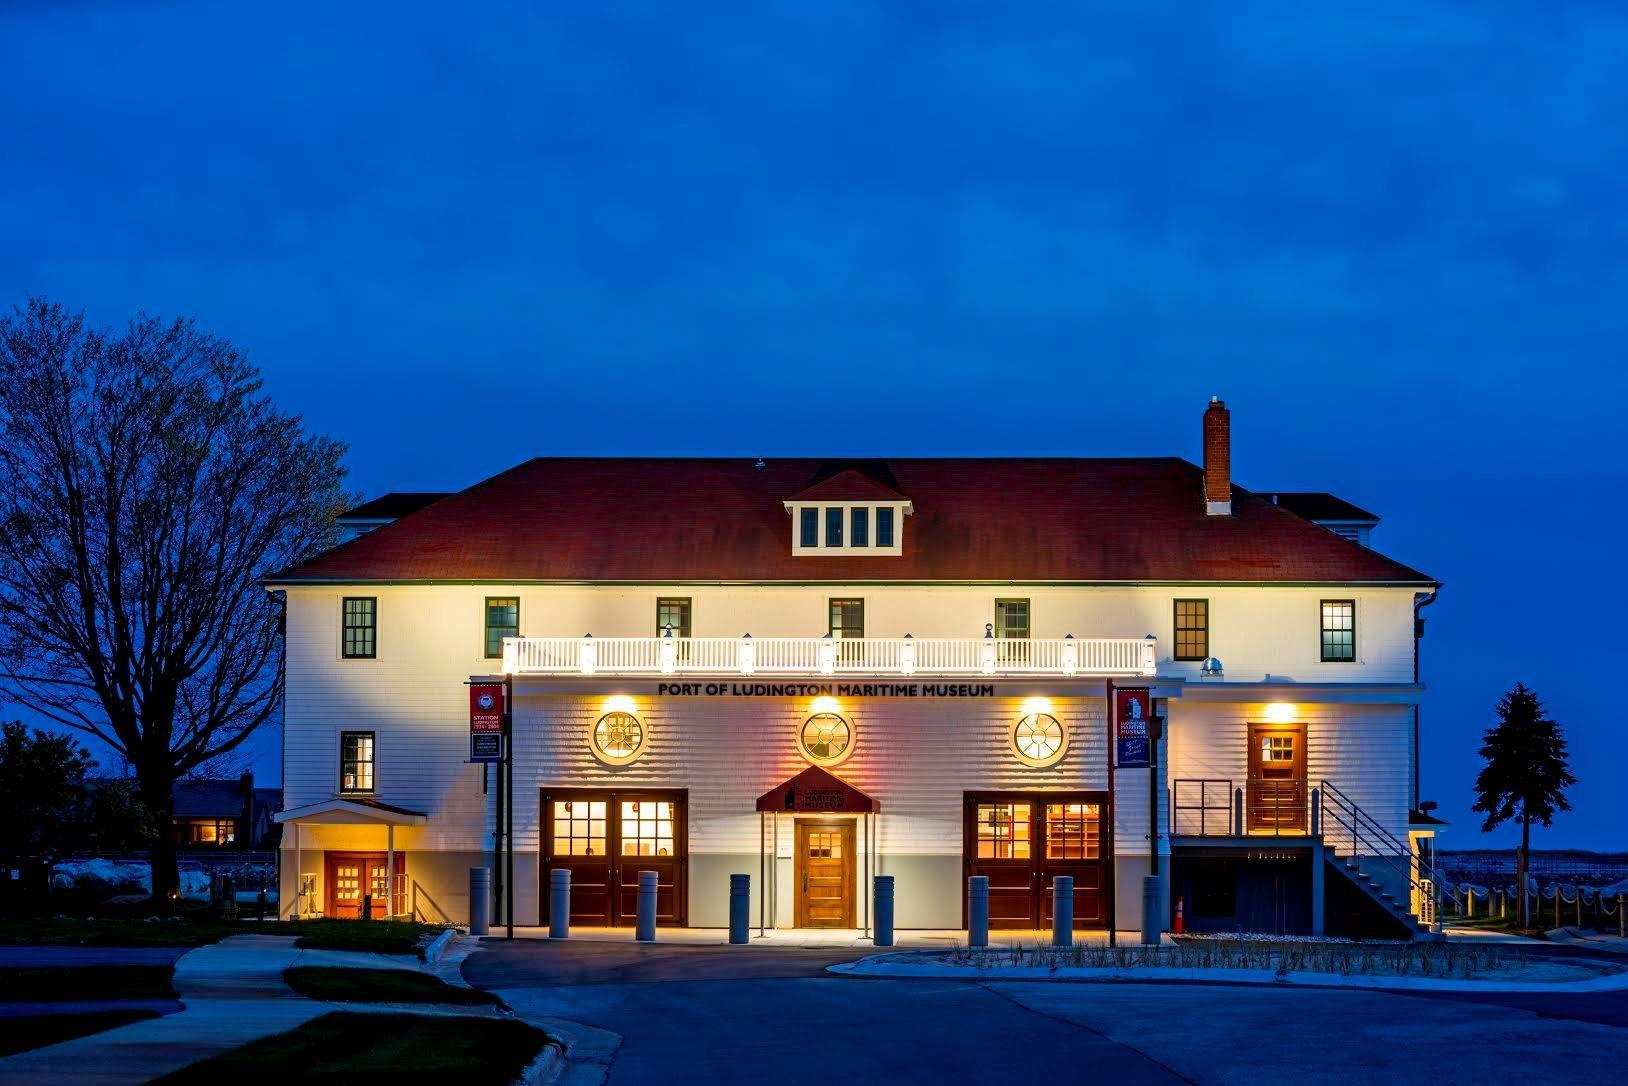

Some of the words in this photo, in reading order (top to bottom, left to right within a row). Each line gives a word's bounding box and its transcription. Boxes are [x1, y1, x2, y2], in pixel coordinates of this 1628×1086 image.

[658, 683, 702, 696] PORT
[705, 683, 728, 696] OF
[732, 683, 832, 697] LUDINGTON
[837, 684, 918, 697] MARITIME
[922, 684, 994, 697] MUSEUM
